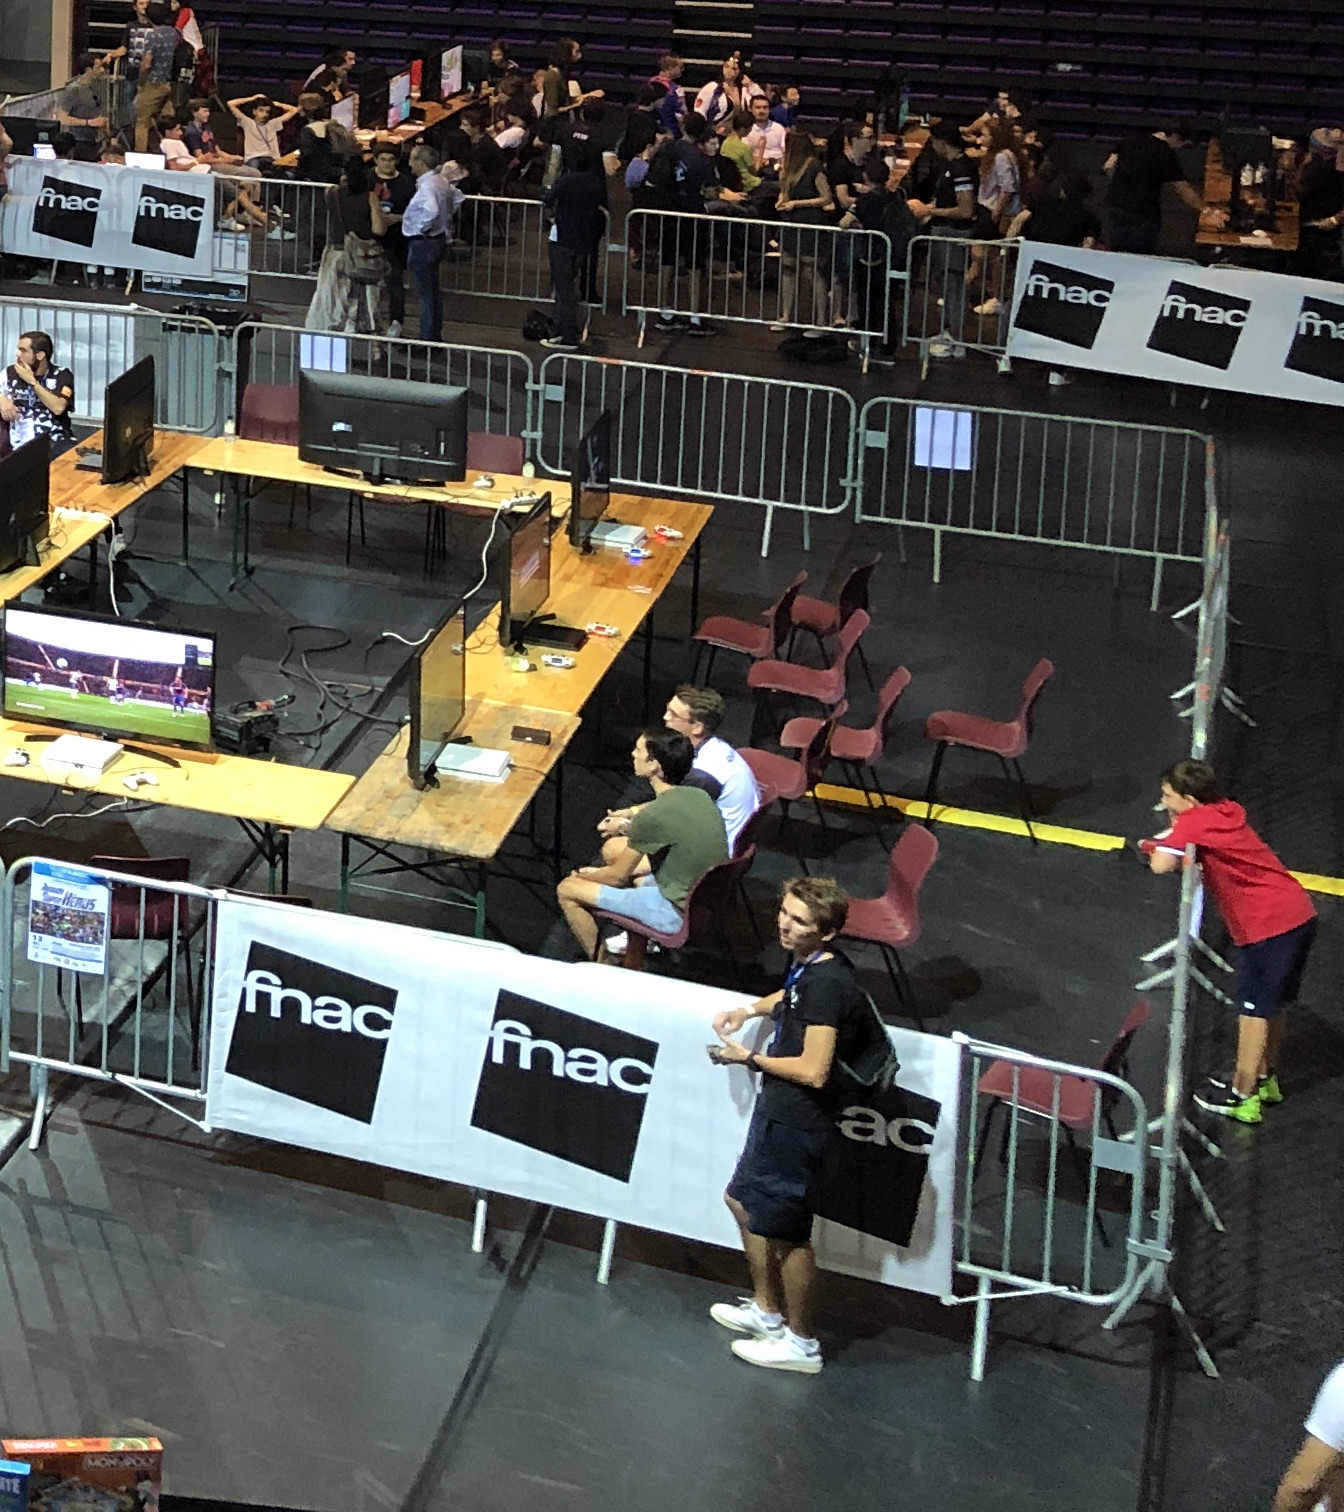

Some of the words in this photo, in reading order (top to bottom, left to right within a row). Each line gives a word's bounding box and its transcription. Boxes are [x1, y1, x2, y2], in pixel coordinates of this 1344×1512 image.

[38, 187, 101, 213] fnac
[137, 195, 205, 222] fnac
[1025, 274, 1113, 308] fnac
[1161, 294, 1248, 327] fnac
[1299, 311, 1344, 340] fn
[242, 969, 397, 1040] fnac
[488, 1019, 656, 1095] fnac
[834, 1105, 936, 1155] ac
[85, 1453, 157, 1469] MONOPOLY
